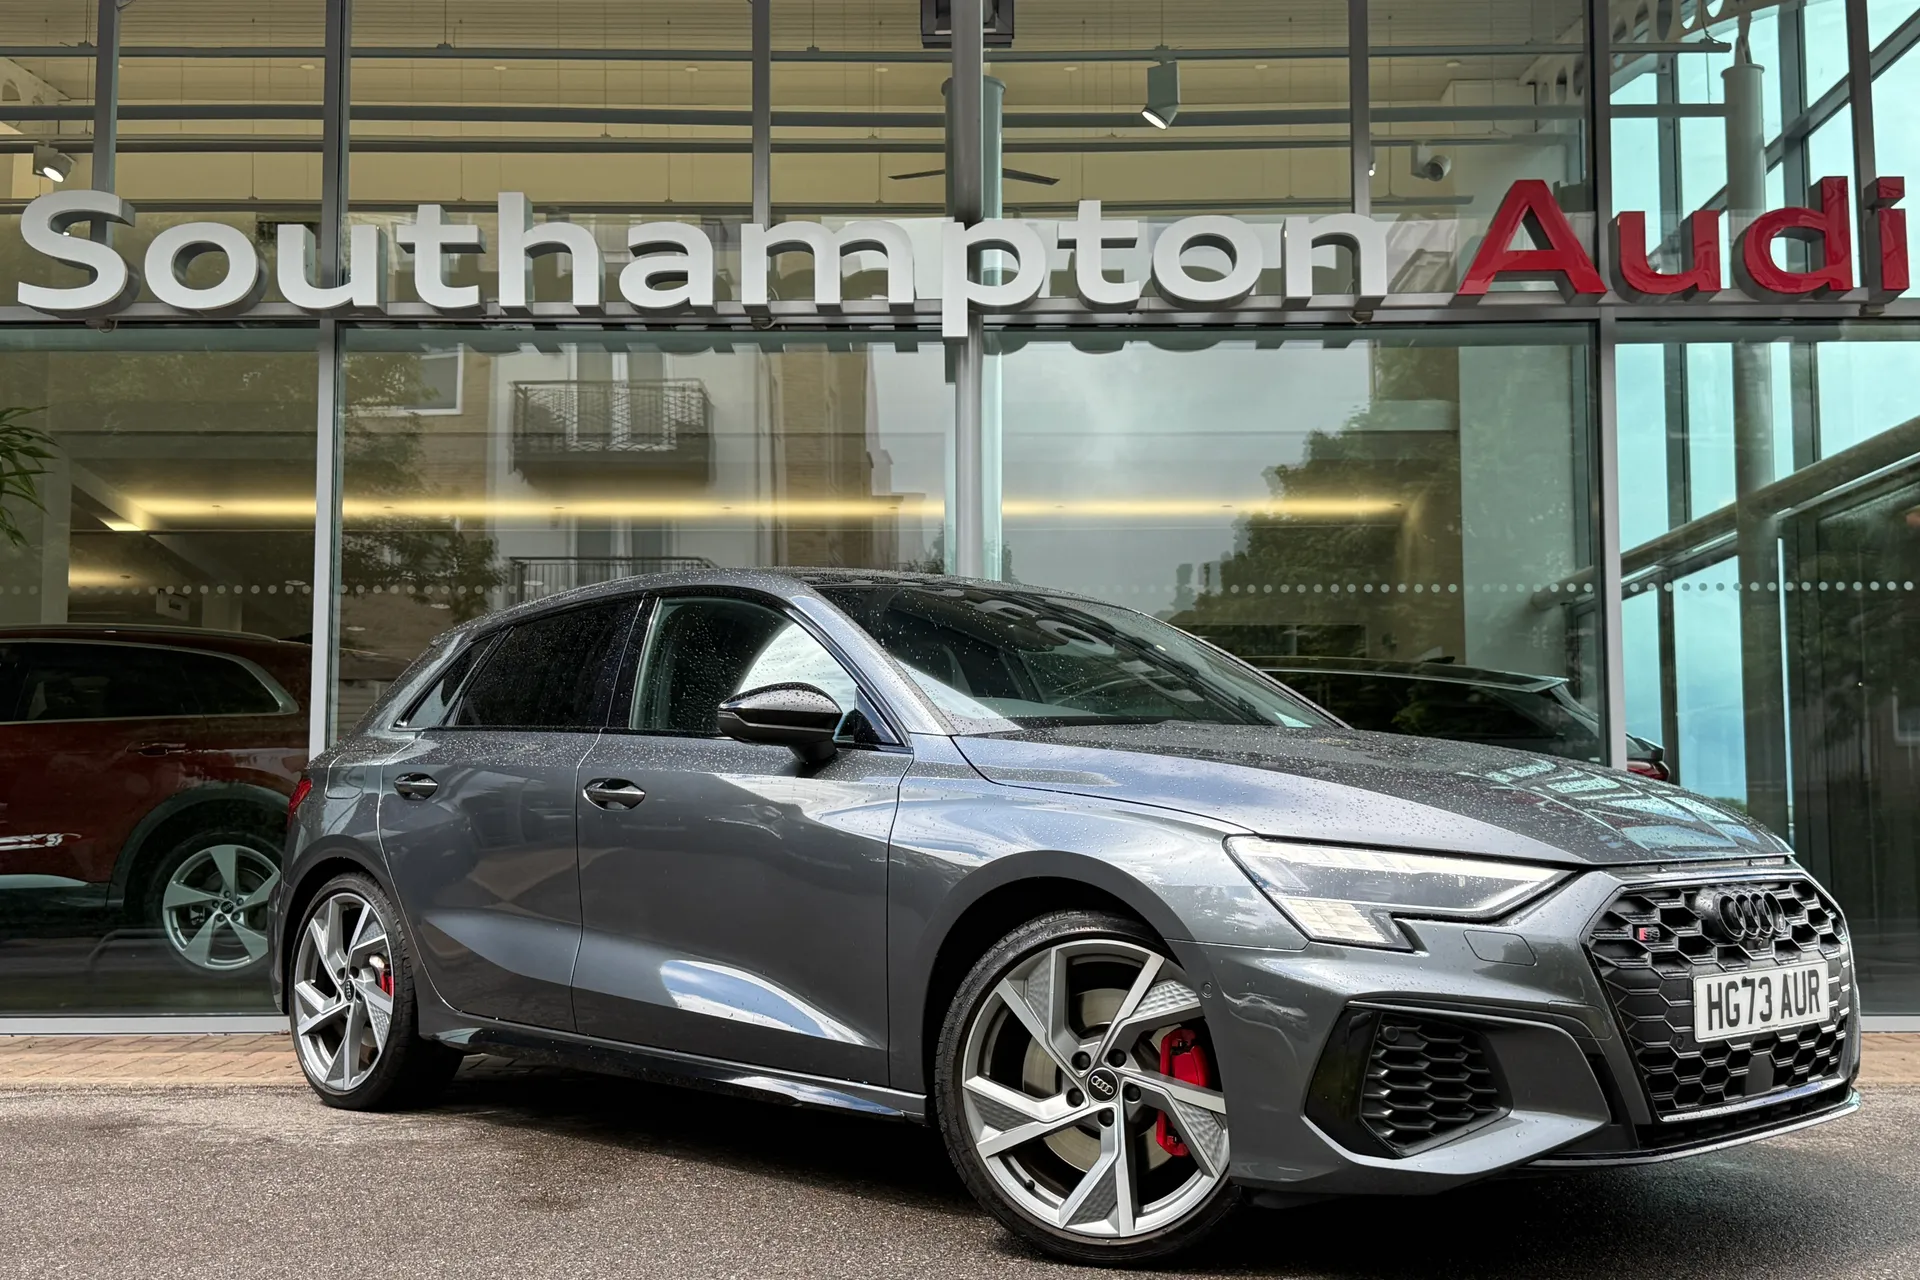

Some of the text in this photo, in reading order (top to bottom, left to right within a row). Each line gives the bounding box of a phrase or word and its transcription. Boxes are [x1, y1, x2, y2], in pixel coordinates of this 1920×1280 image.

[17, 176, 1911, 342] Southampton Audi
[1706, 968, 1821, 1031] HG73 AUR
